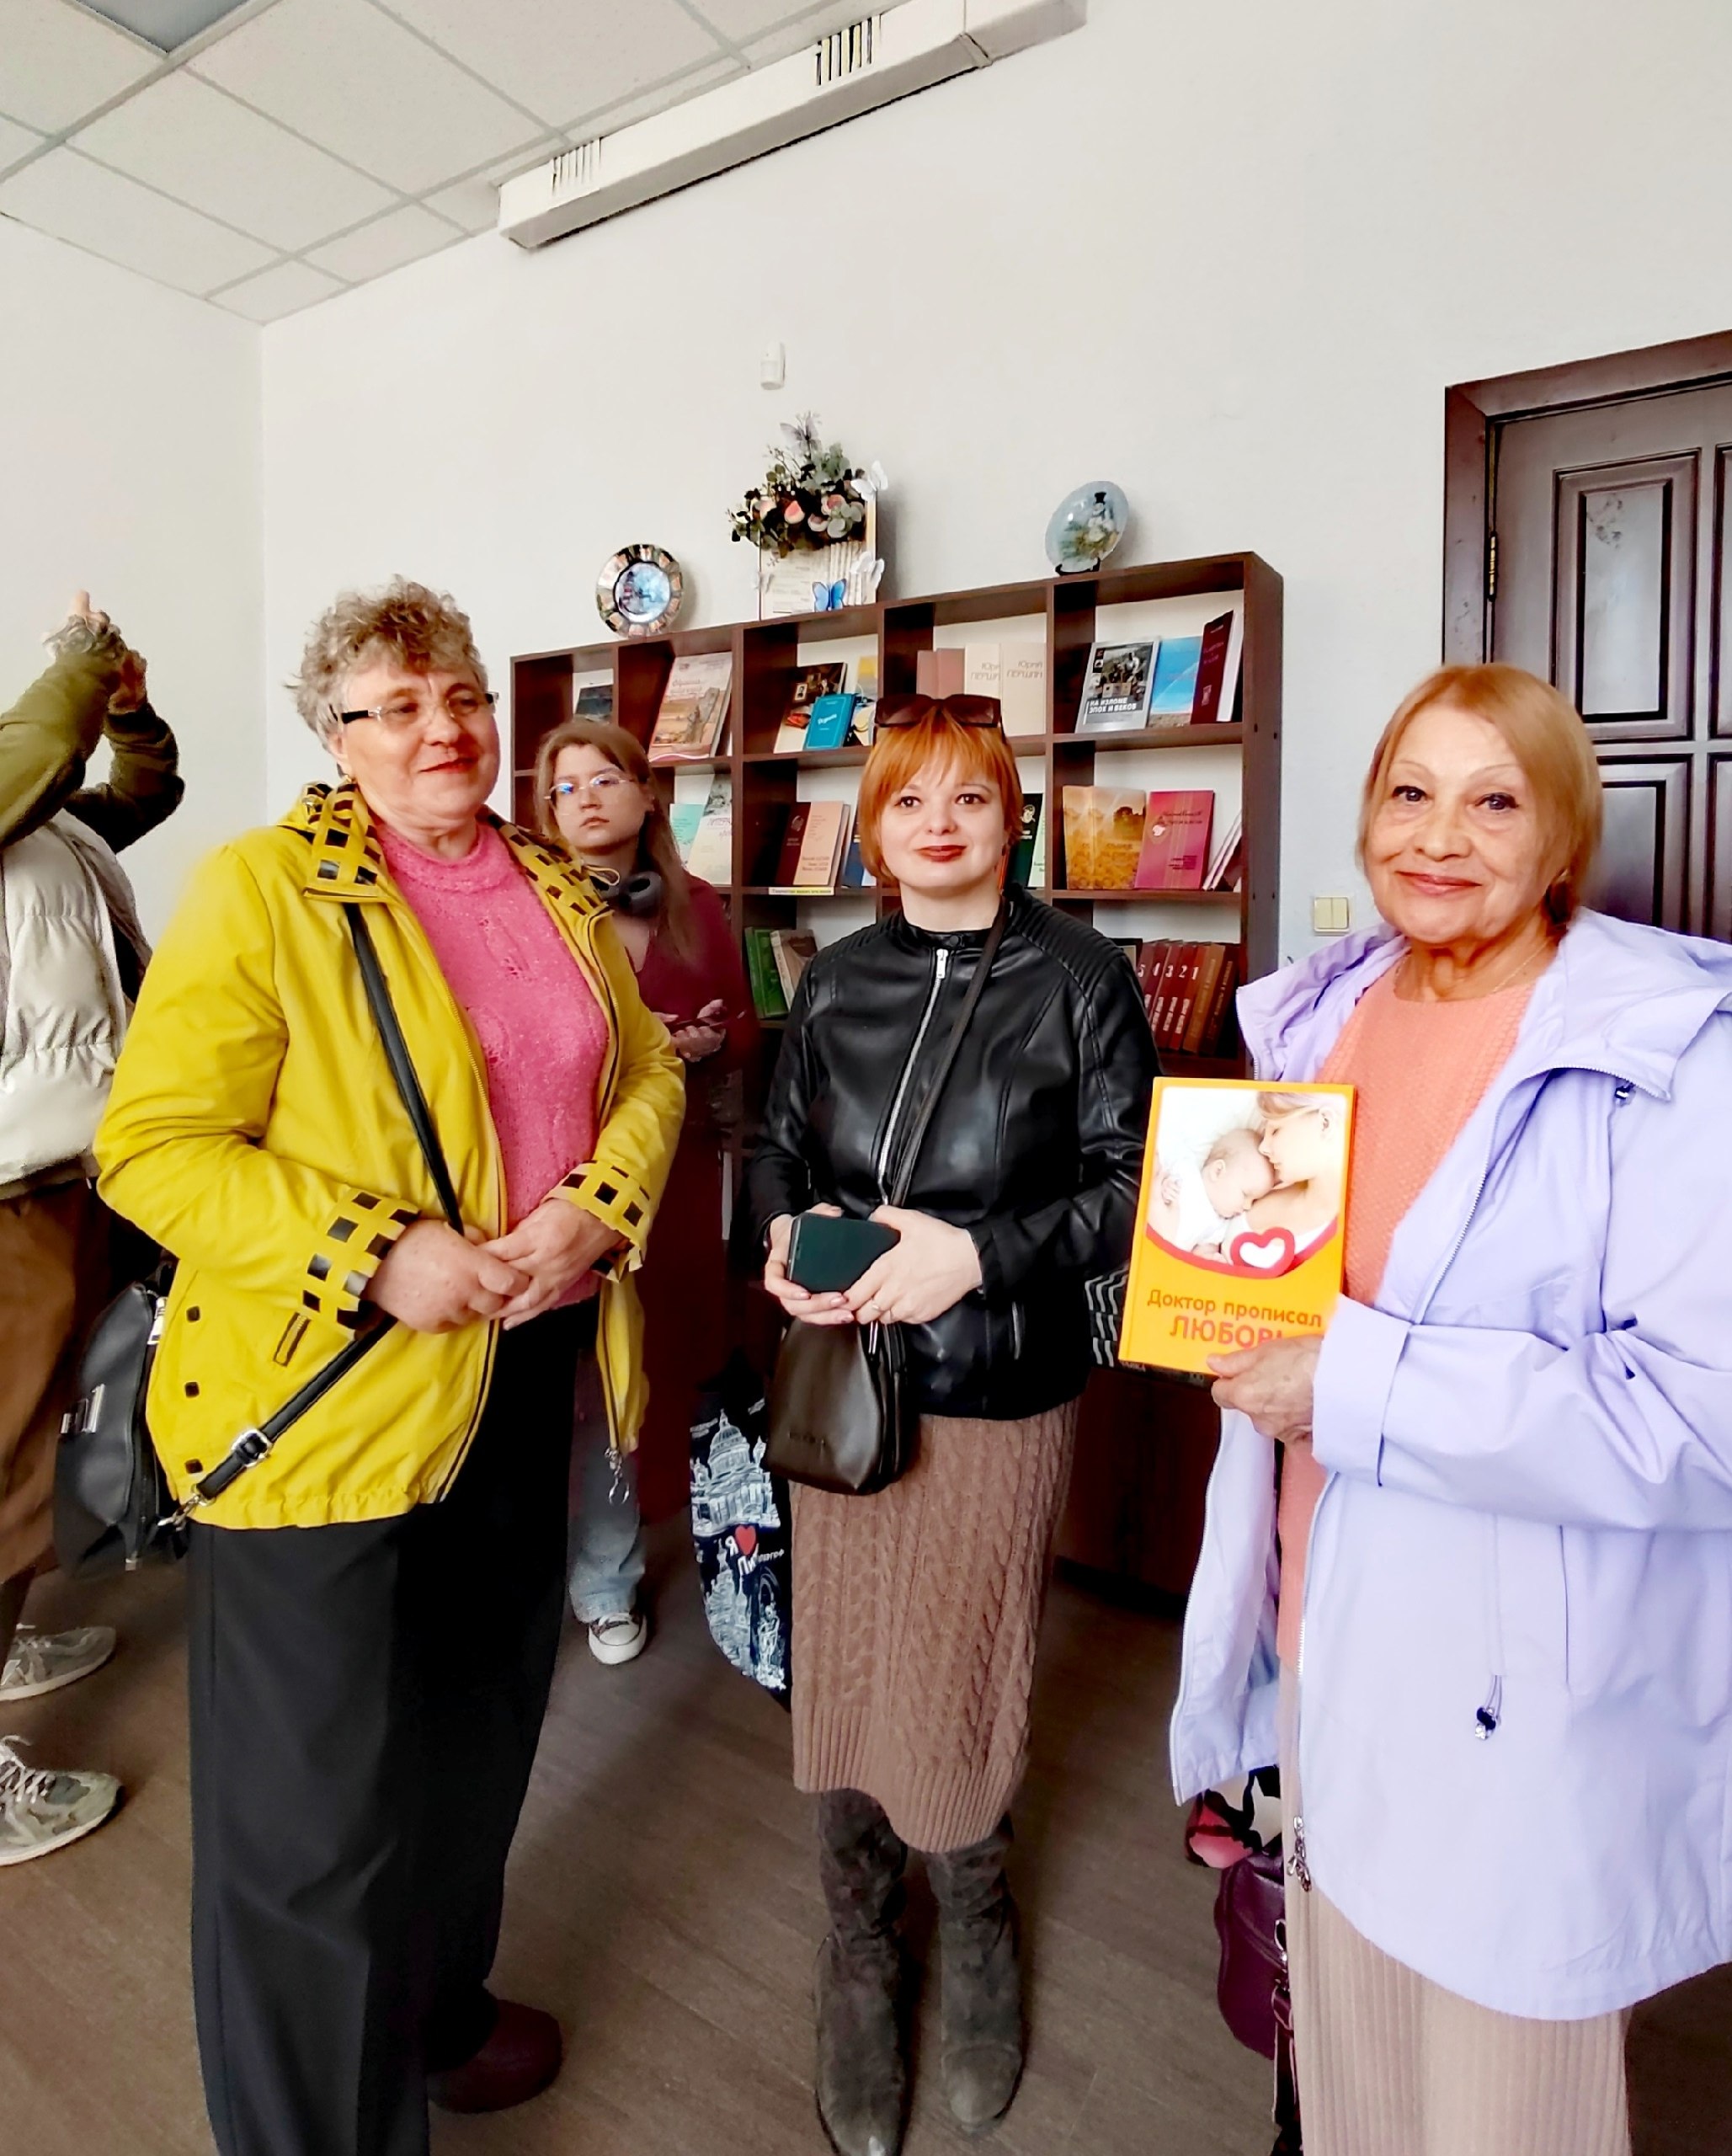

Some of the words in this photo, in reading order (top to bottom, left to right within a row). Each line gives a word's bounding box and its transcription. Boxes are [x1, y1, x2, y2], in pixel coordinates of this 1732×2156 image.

[1089, 706, 1106, 714] ЭПОХ
[1114, 703, 1137, 712] ВЕКОВ
[1100, 697, 1127, 706] ИЗЛОМЕ
[1147, 1289, 1216, 1316] Доктор
[1223, 1302, 1322, 1328] прописал
[725, 1535, 738, 1557] Я
